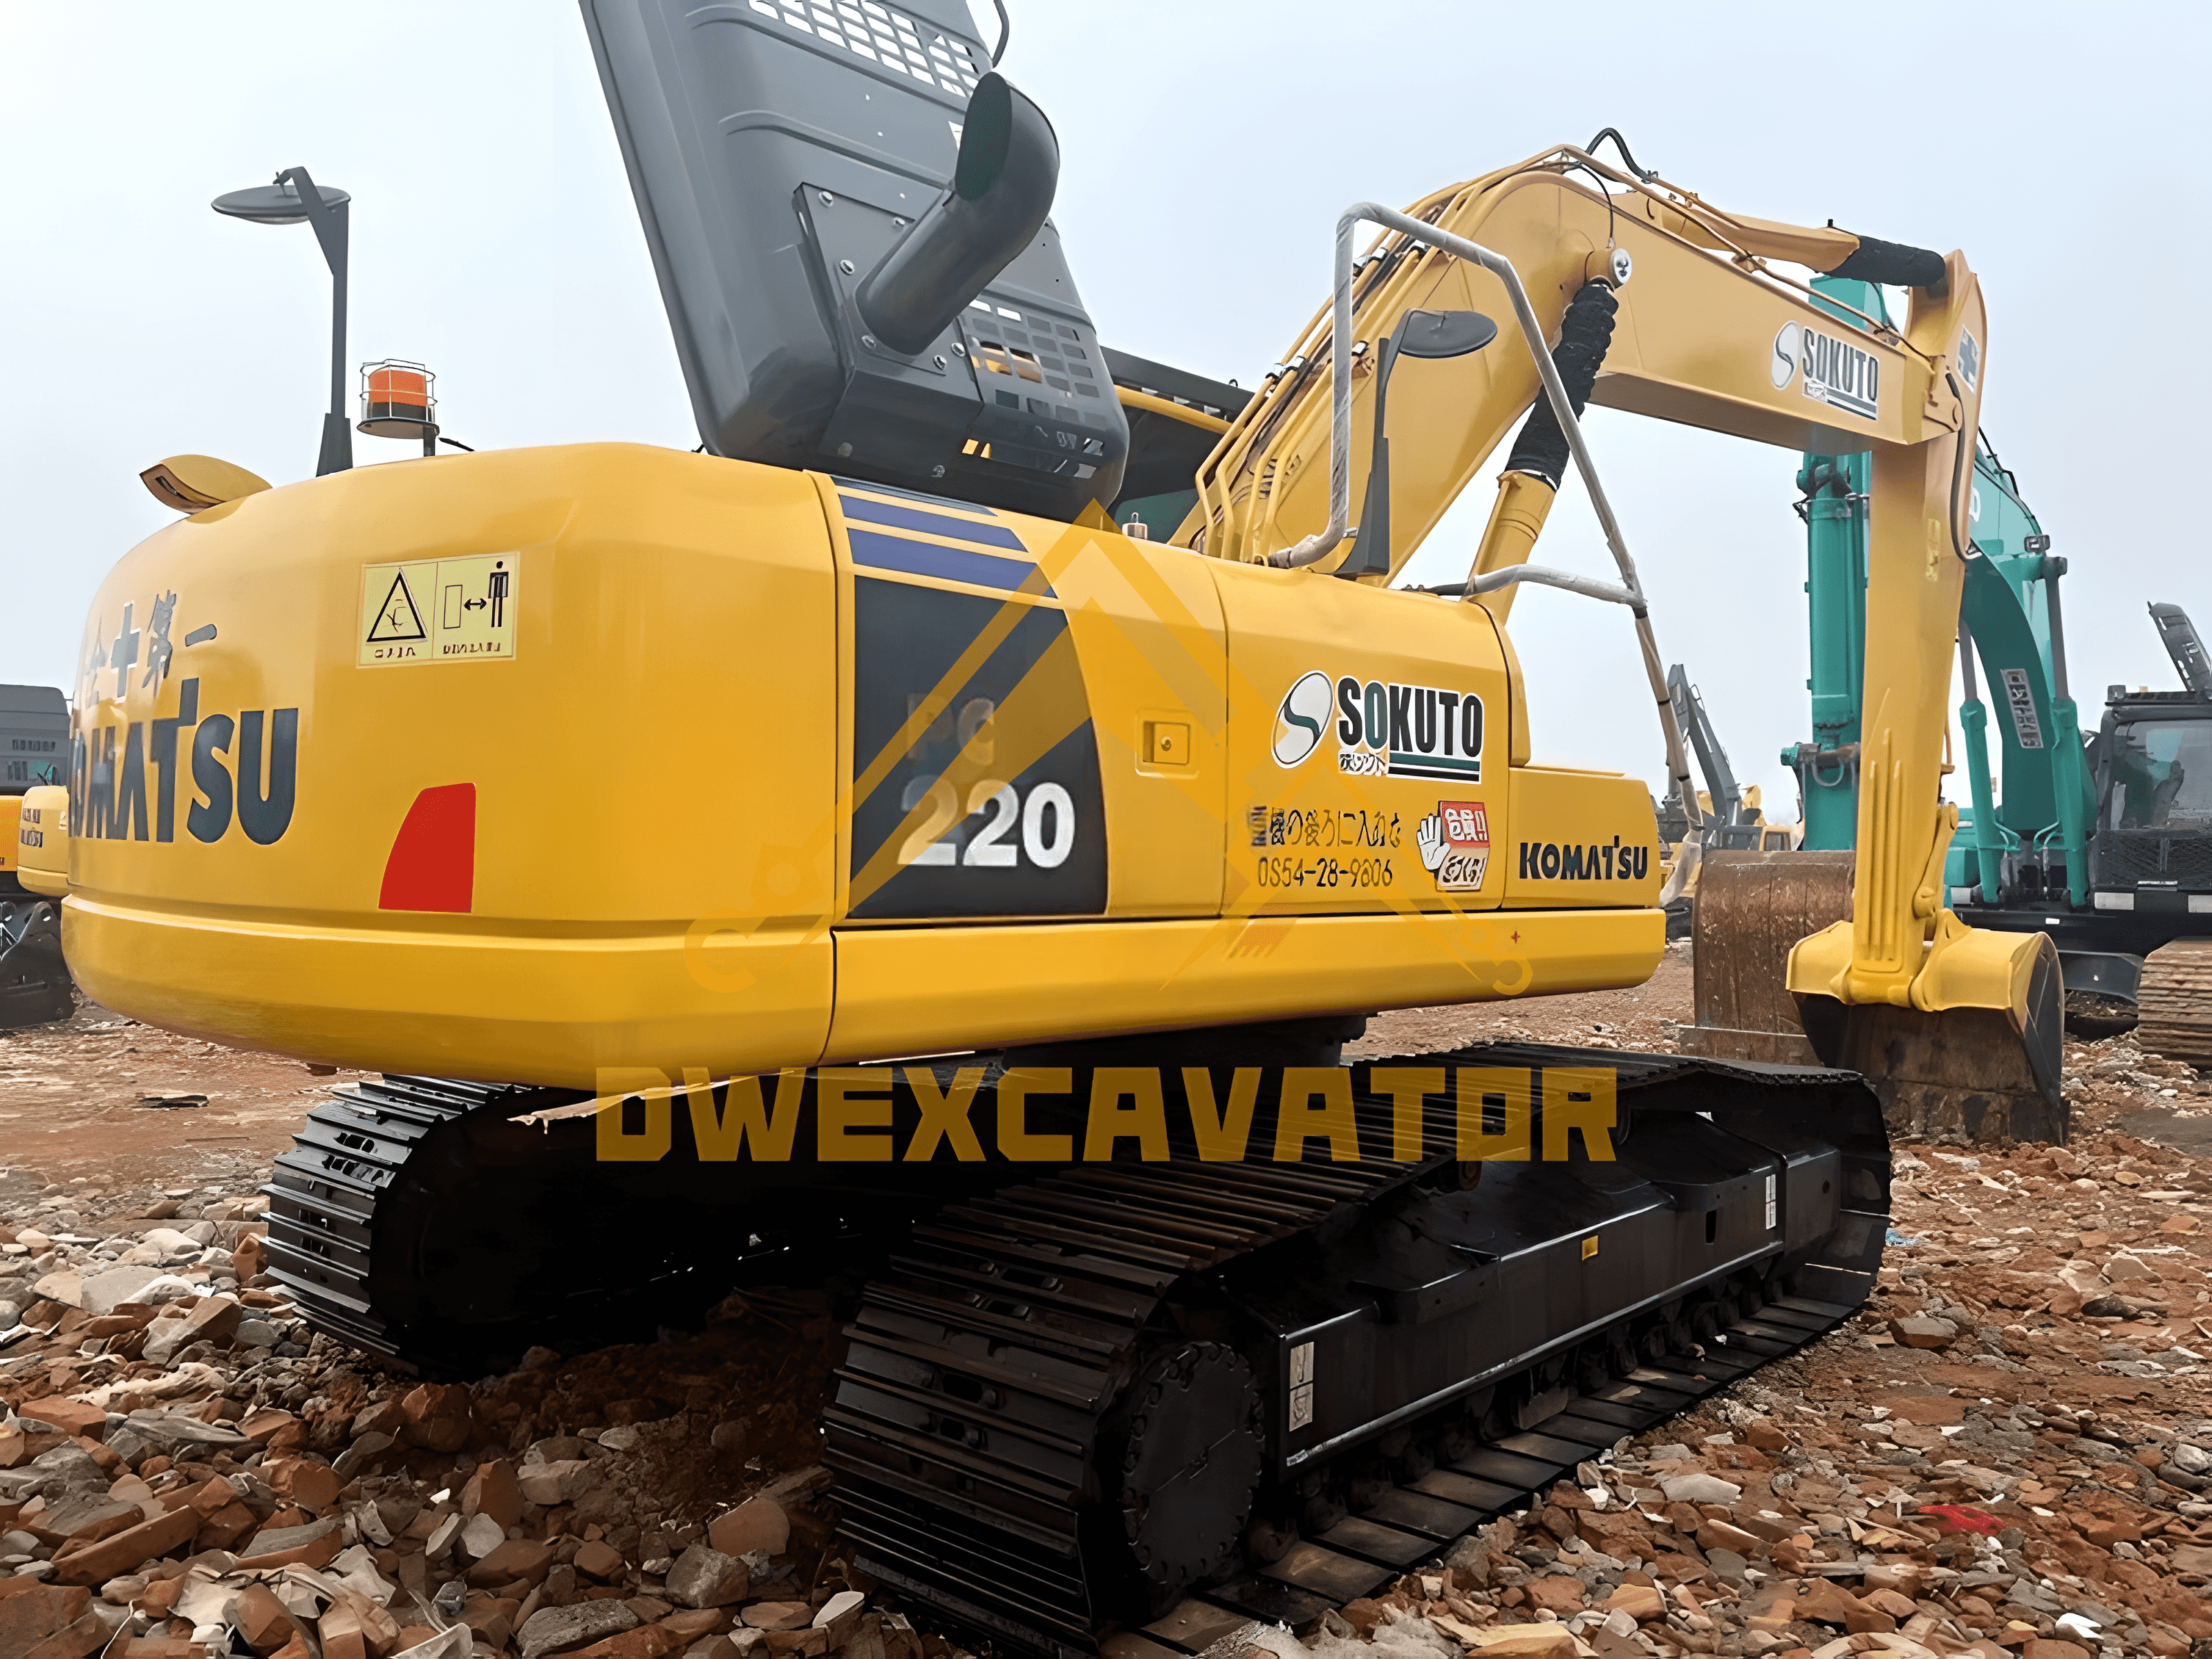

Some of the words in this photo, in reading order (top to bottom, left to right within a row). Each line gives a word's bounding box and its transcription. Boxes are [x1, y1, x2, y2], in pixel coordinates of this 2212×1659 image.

[1803, 328, 1878, 402] SOKUTO
[906, 693, 995, 766] PC
[1337, 675, 1484, 758] SOKUTO
[69, 677, 299, 845] OMATSU
[897, 775, 1076, 868] 220
[1519, 834, 1648, 880] KOMATSU
